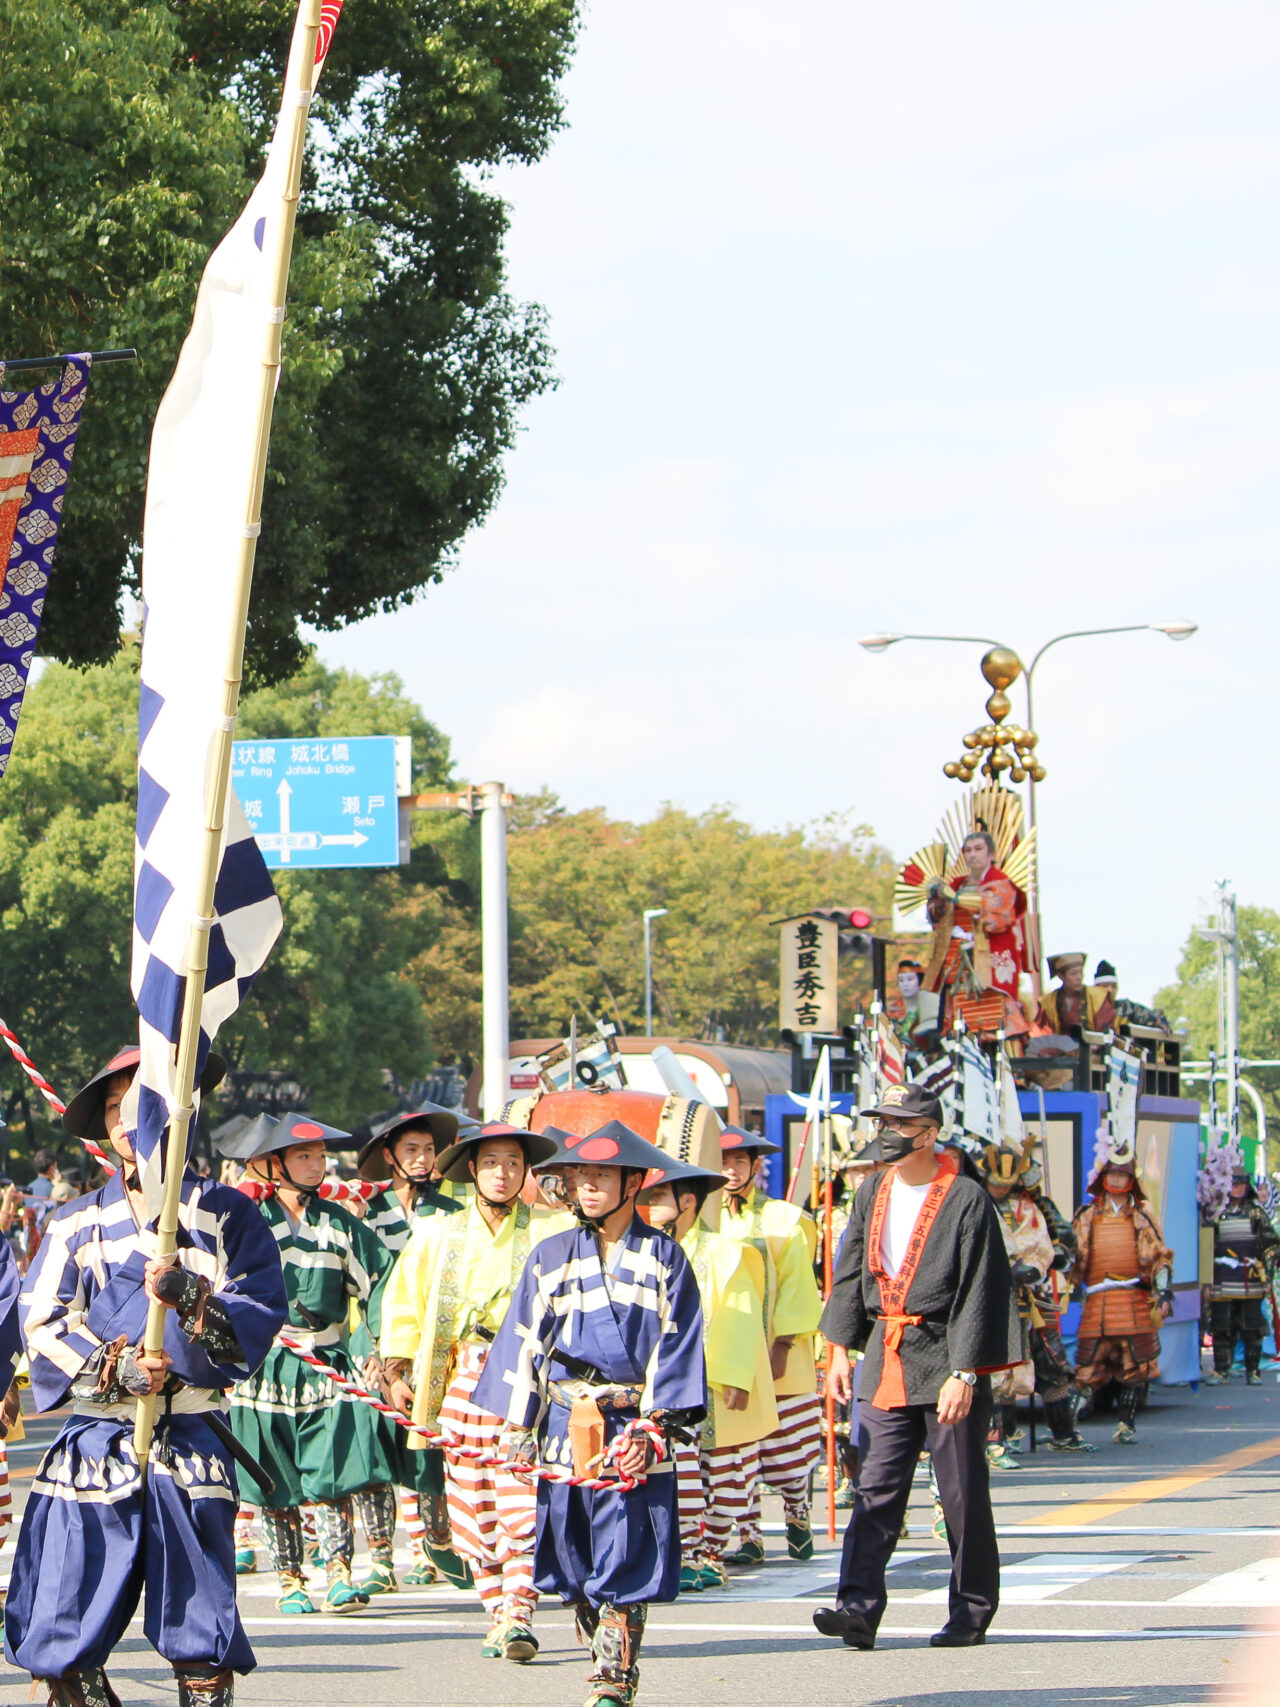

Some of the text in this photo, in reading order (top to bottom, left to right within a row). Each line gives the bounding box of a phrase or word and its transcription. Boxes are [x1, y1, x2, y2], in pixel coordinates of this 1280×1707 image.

[291, 743, 350, 763] 城北橋
[251, 767, 273, 778] Ring
[285, 765, 321, 776] Johoku
[325, 764, 356, 775] Bridge
[341, 795, 386, 816] 瀬戸
[353, 816, 376, 827] Seto
[793, 919, 825, 1026] 豊臣秀吉
